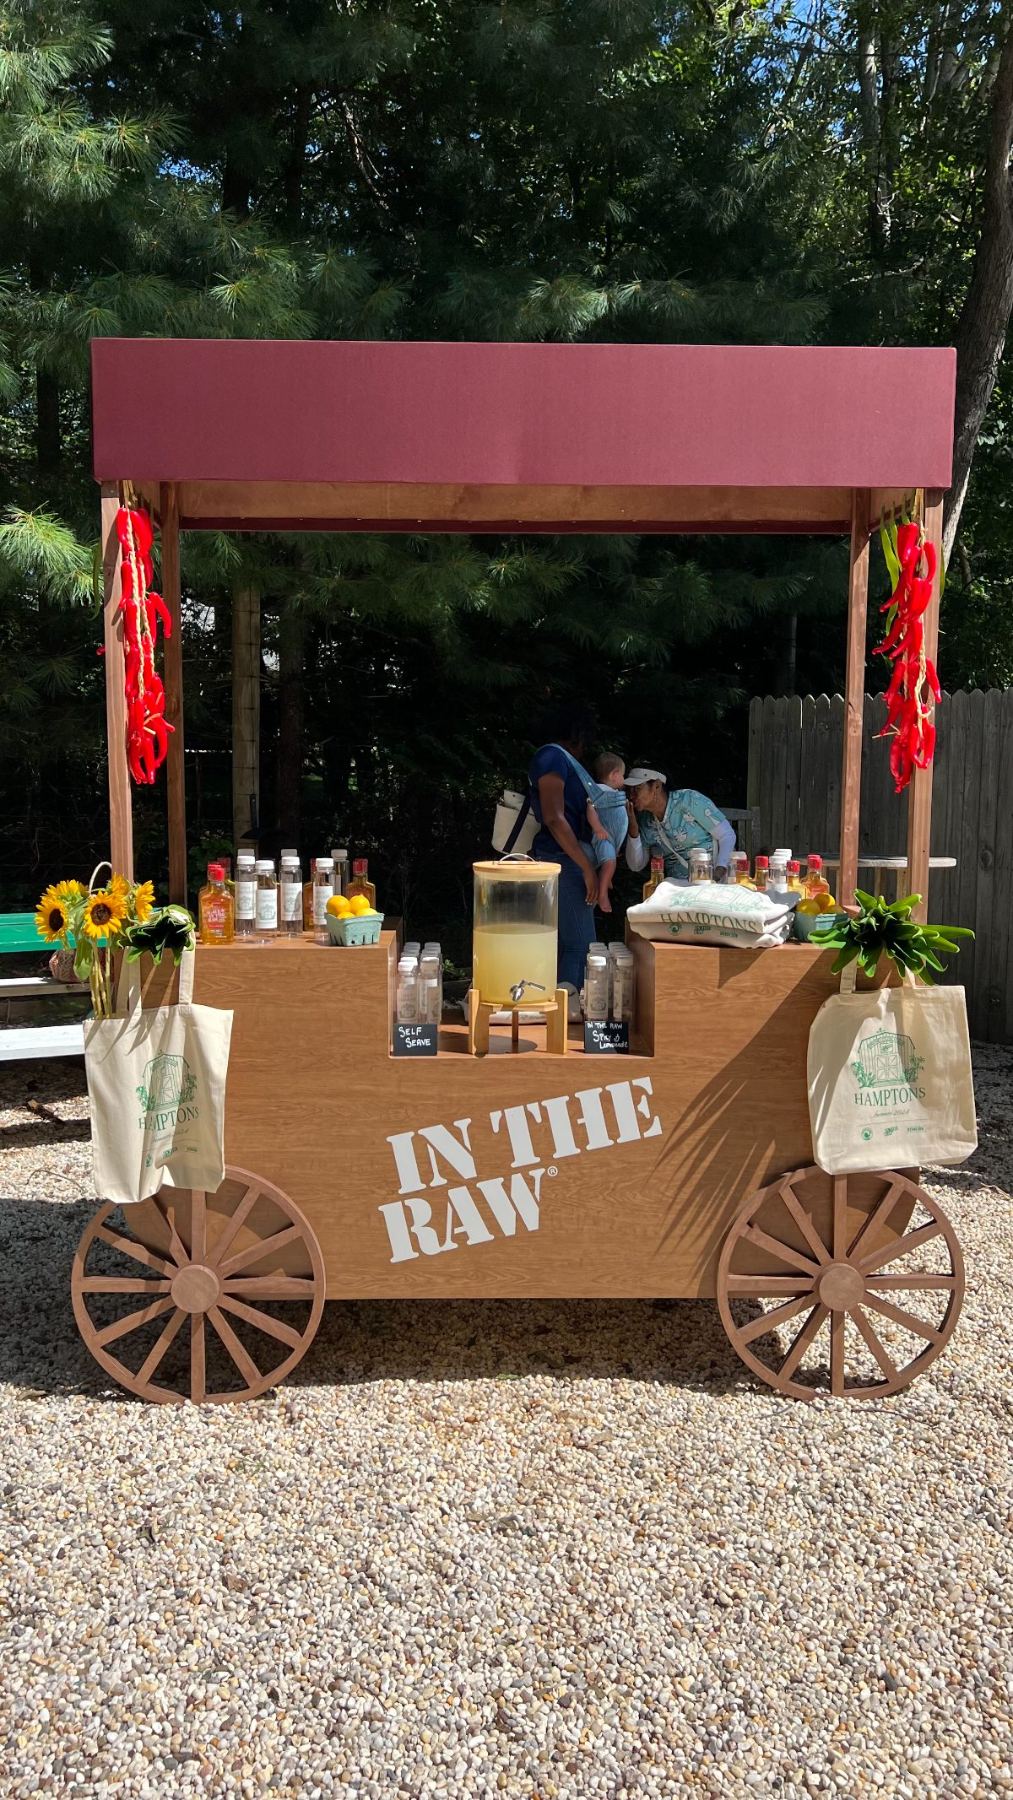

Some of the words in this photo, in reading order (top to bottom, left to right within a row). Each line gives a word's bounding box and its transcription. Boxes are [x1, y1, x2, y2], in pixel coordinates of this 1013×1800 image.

[398, 1026, 423, 1038] SELF
[609, 1022, 623, 1030] RAW
[854, 1087, 926, 1107] HAMPTONS
[386, 1117, 478, 1195] IN
[489, 1076, 663, 1168] THE
